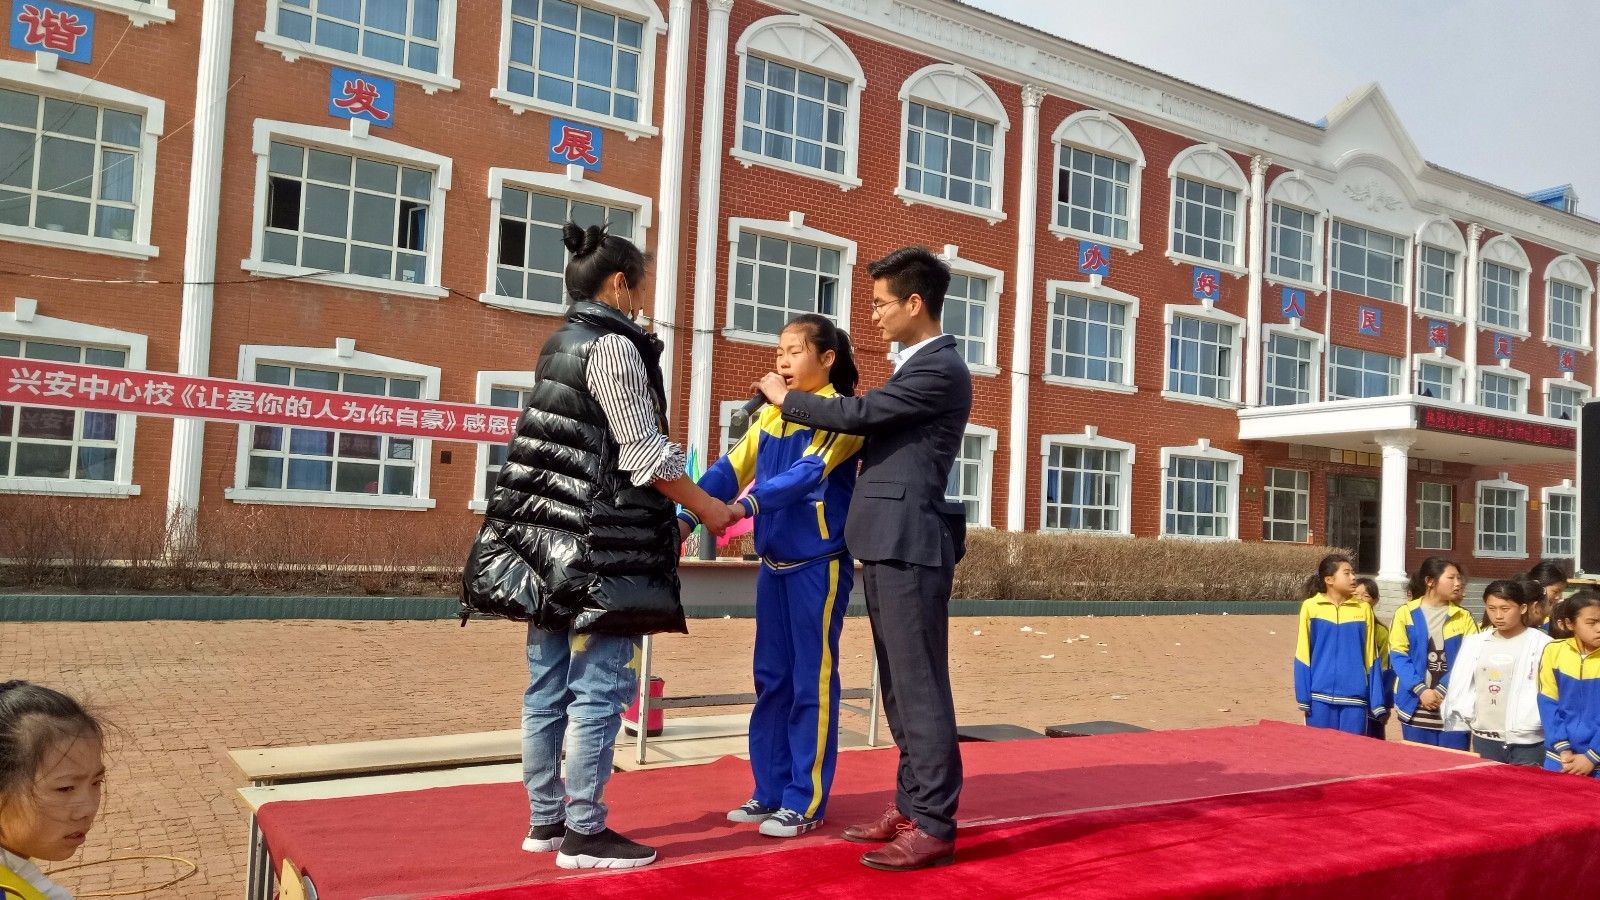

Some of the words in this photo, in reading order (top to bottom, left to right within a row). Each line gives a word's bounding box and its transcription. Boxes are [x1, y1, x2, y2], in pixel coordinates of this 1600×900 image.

[17, 4, 88, 54] 谐
[333, 79, 390, 121] 发
[552, 125, 599, 165] 展
[1081, 244, 1110, 271] 办
[1195, 272, 1220, 297] 好
[1283, 291, 1305, 318] 人
[1361, 308, 1380, 333] 民
